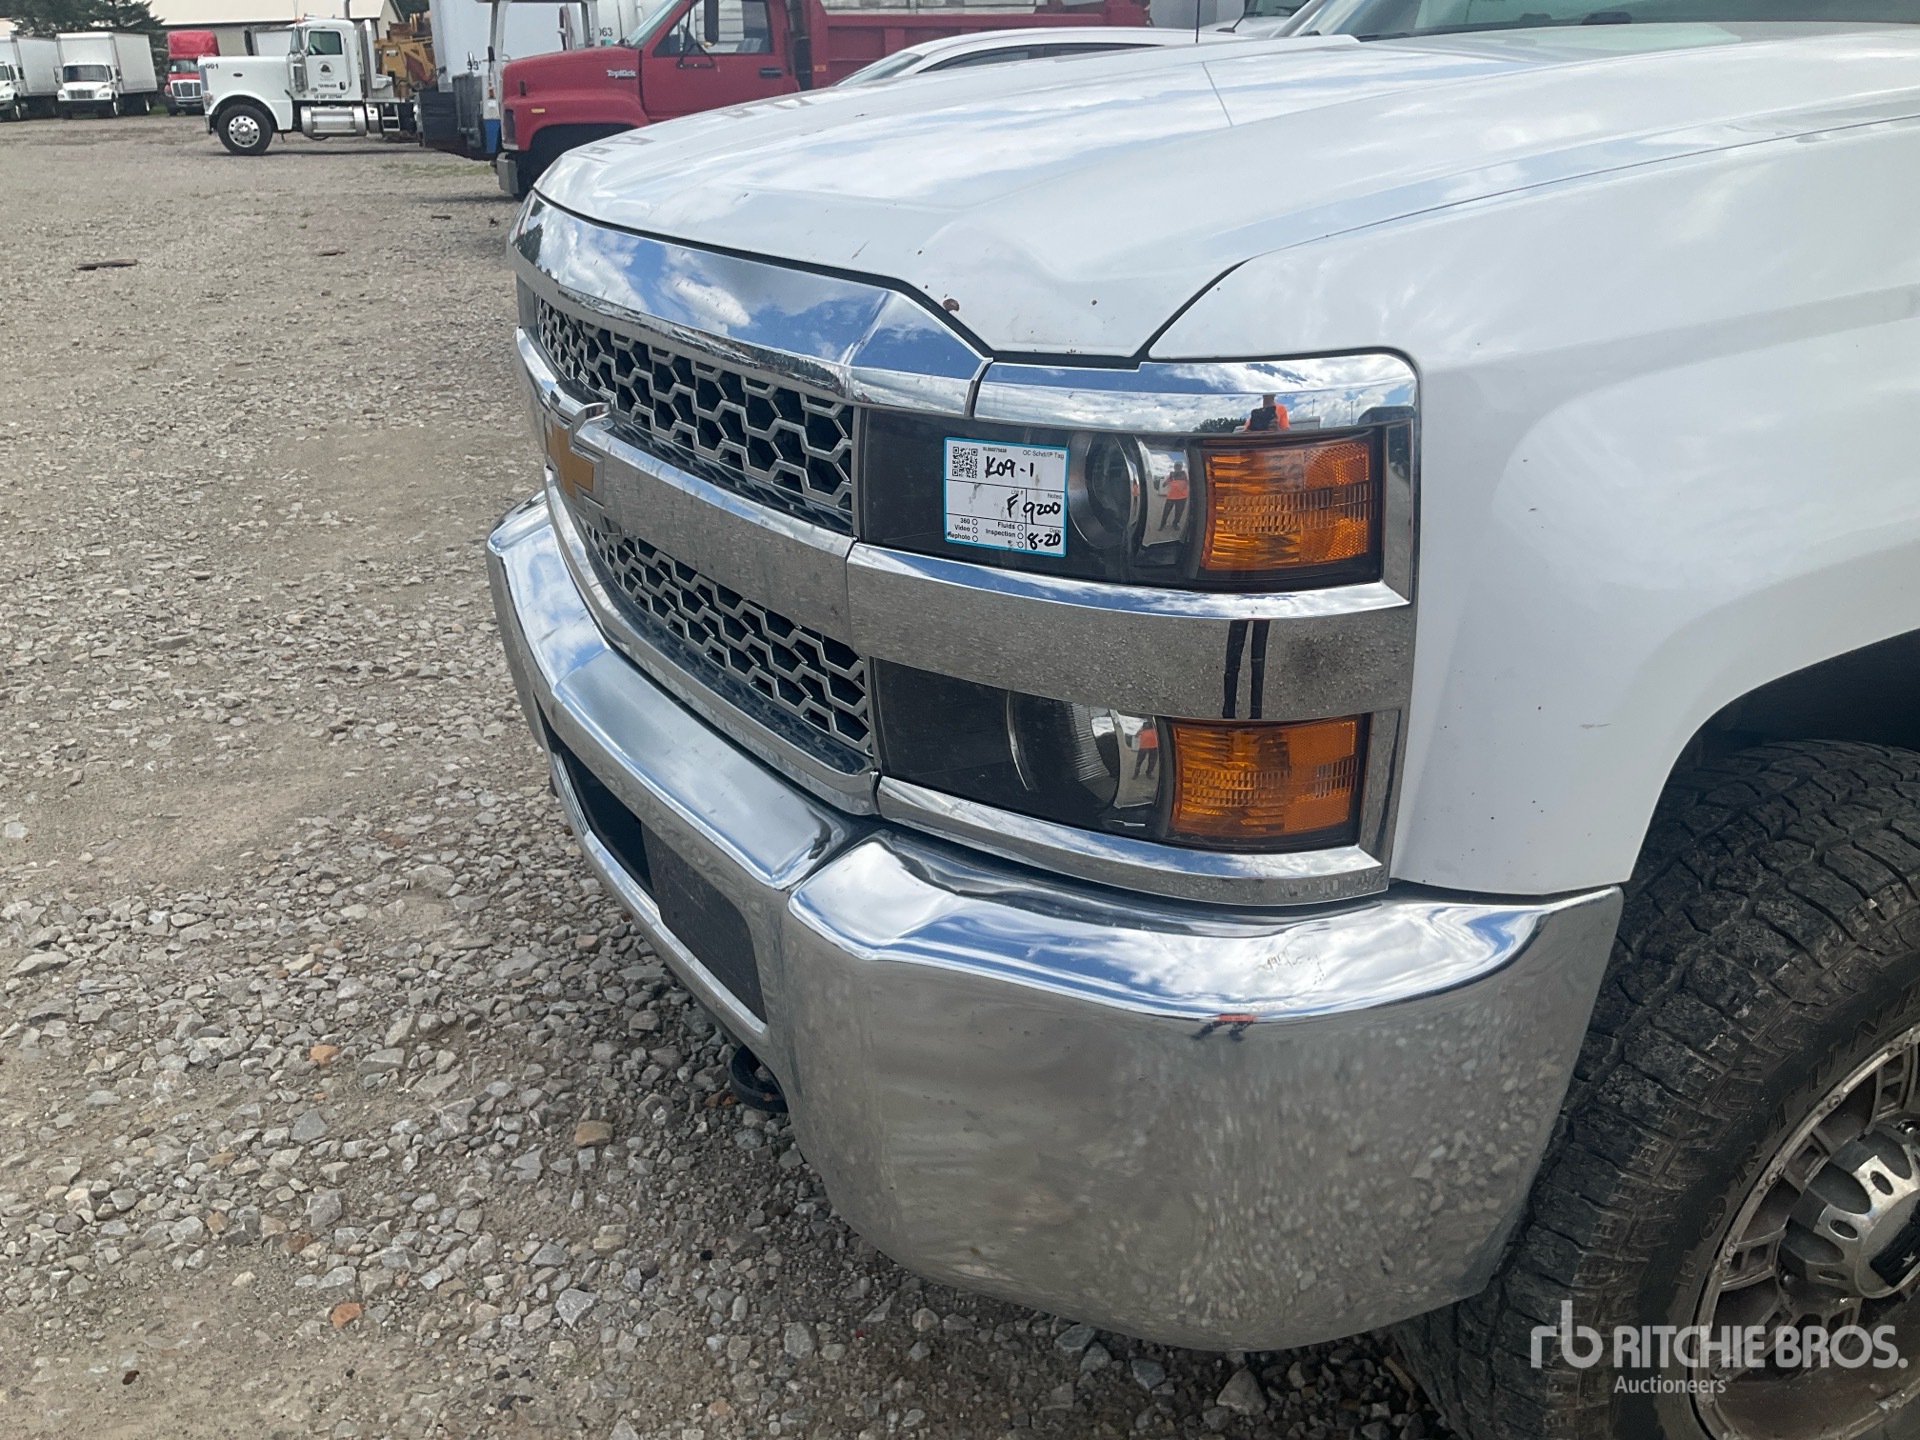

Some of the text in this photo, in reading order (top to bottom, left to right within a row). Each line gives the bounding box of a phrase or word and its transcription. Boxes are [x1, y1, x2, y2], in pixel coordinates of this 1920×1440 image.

[1023, 501, 1061, 525] 9200
[954, 524, 970, 532] Video
[997, 521, 1015, 530] Fluids
[985, 528, 1016, 538] Inspection
